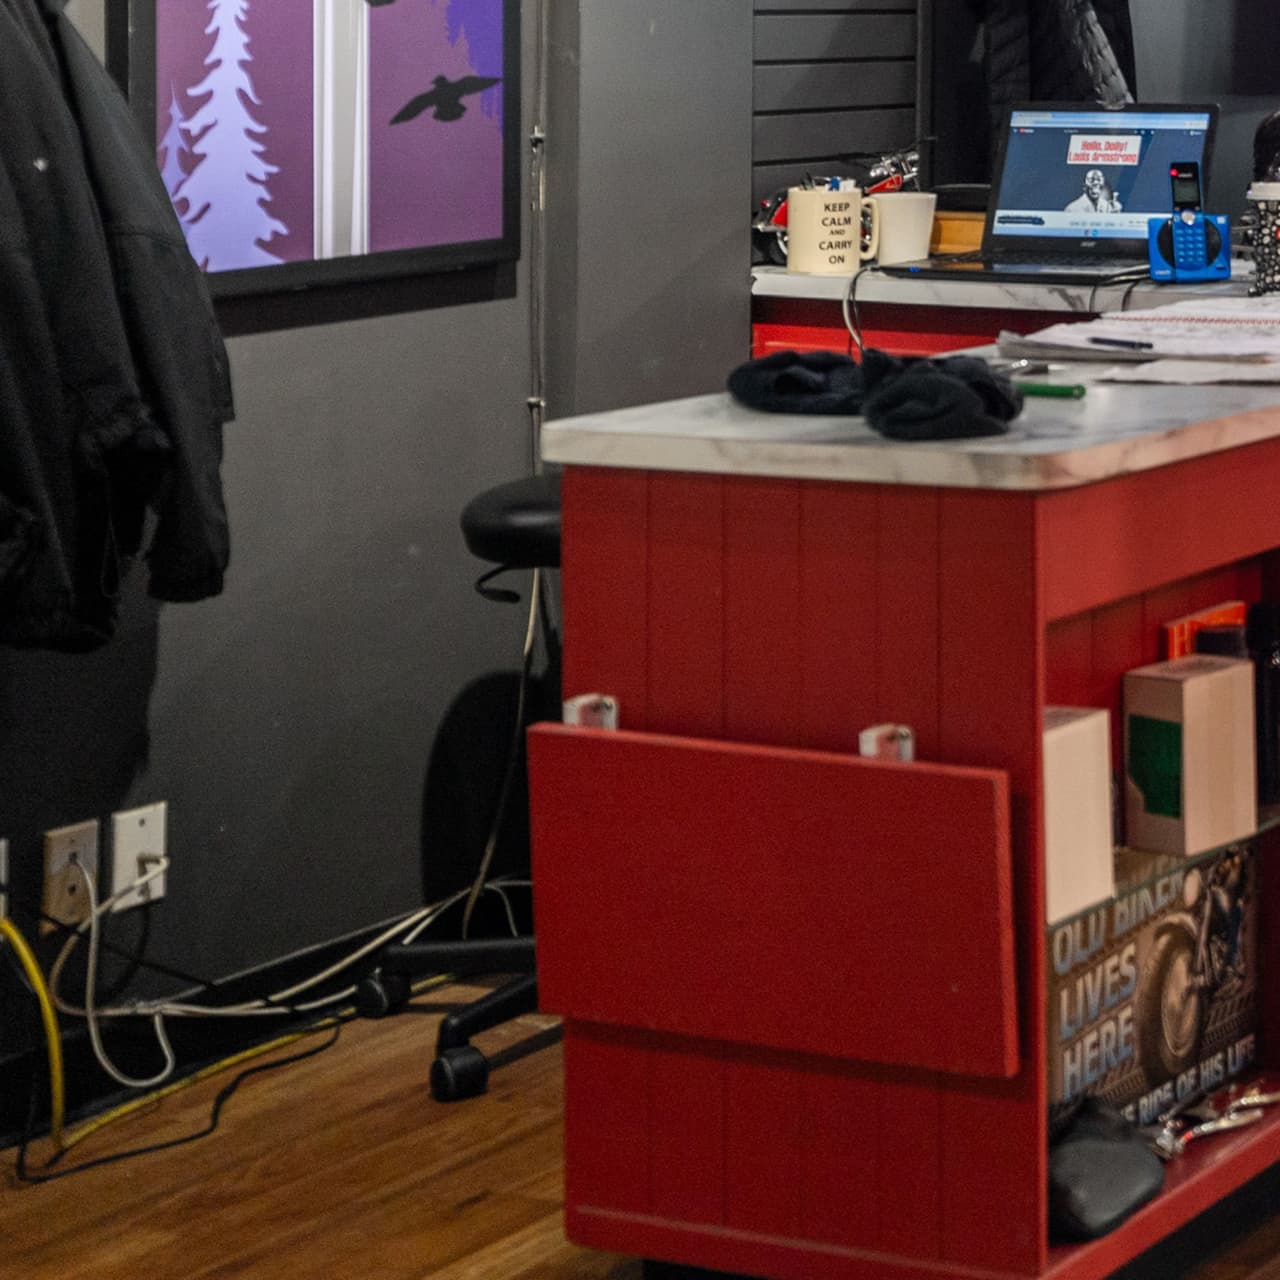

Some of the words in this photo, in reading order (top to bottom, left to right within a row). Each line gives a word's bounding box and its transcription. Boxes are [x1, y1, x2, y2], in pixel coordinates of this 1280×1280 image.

[1092, 152, 1137, 163] Armstrong
[824, 202, 850, 212] KEEP
[821, 217, 852, 227] CALM
[818, 240, 852, 251] CARRY
[828, 255, 845, 264] ON
[1059, 943, 1137, 1041] LIVES
[1063, 1004, 1134, 1103] HERE
[1139, 1080, 1175, 1124] RIDE
[1177, 1065, 1198, 1101] OF
[1200, 1051, 1225, 1091] HIS
